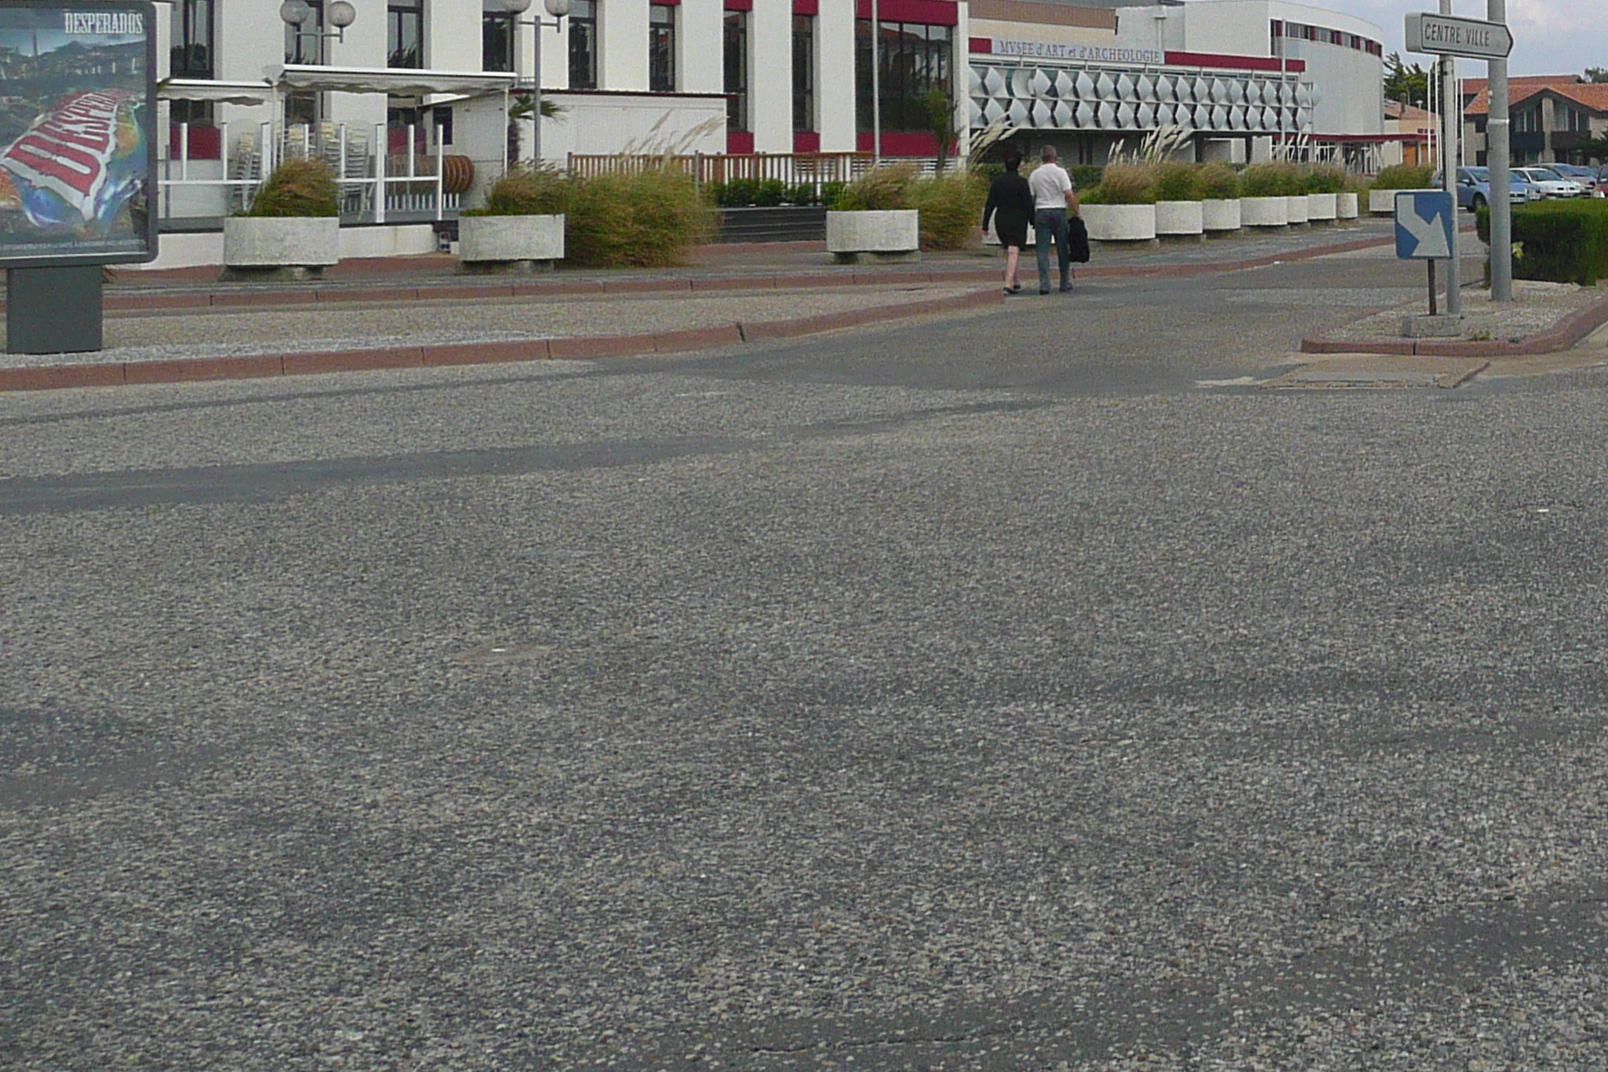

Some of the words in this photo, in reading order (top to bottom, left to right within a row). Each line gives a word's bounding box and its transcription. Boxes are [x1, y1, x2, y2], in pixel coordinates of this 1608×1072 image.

[64, 12, 143, 34] DESPERADOS
[1424, 23, 1461, 44] CENTRE
[1465, 28, 1490, 47] VILLE
[1036, 41, 1067, 58] d'ART
[1068, 47, 1077, 58] et
